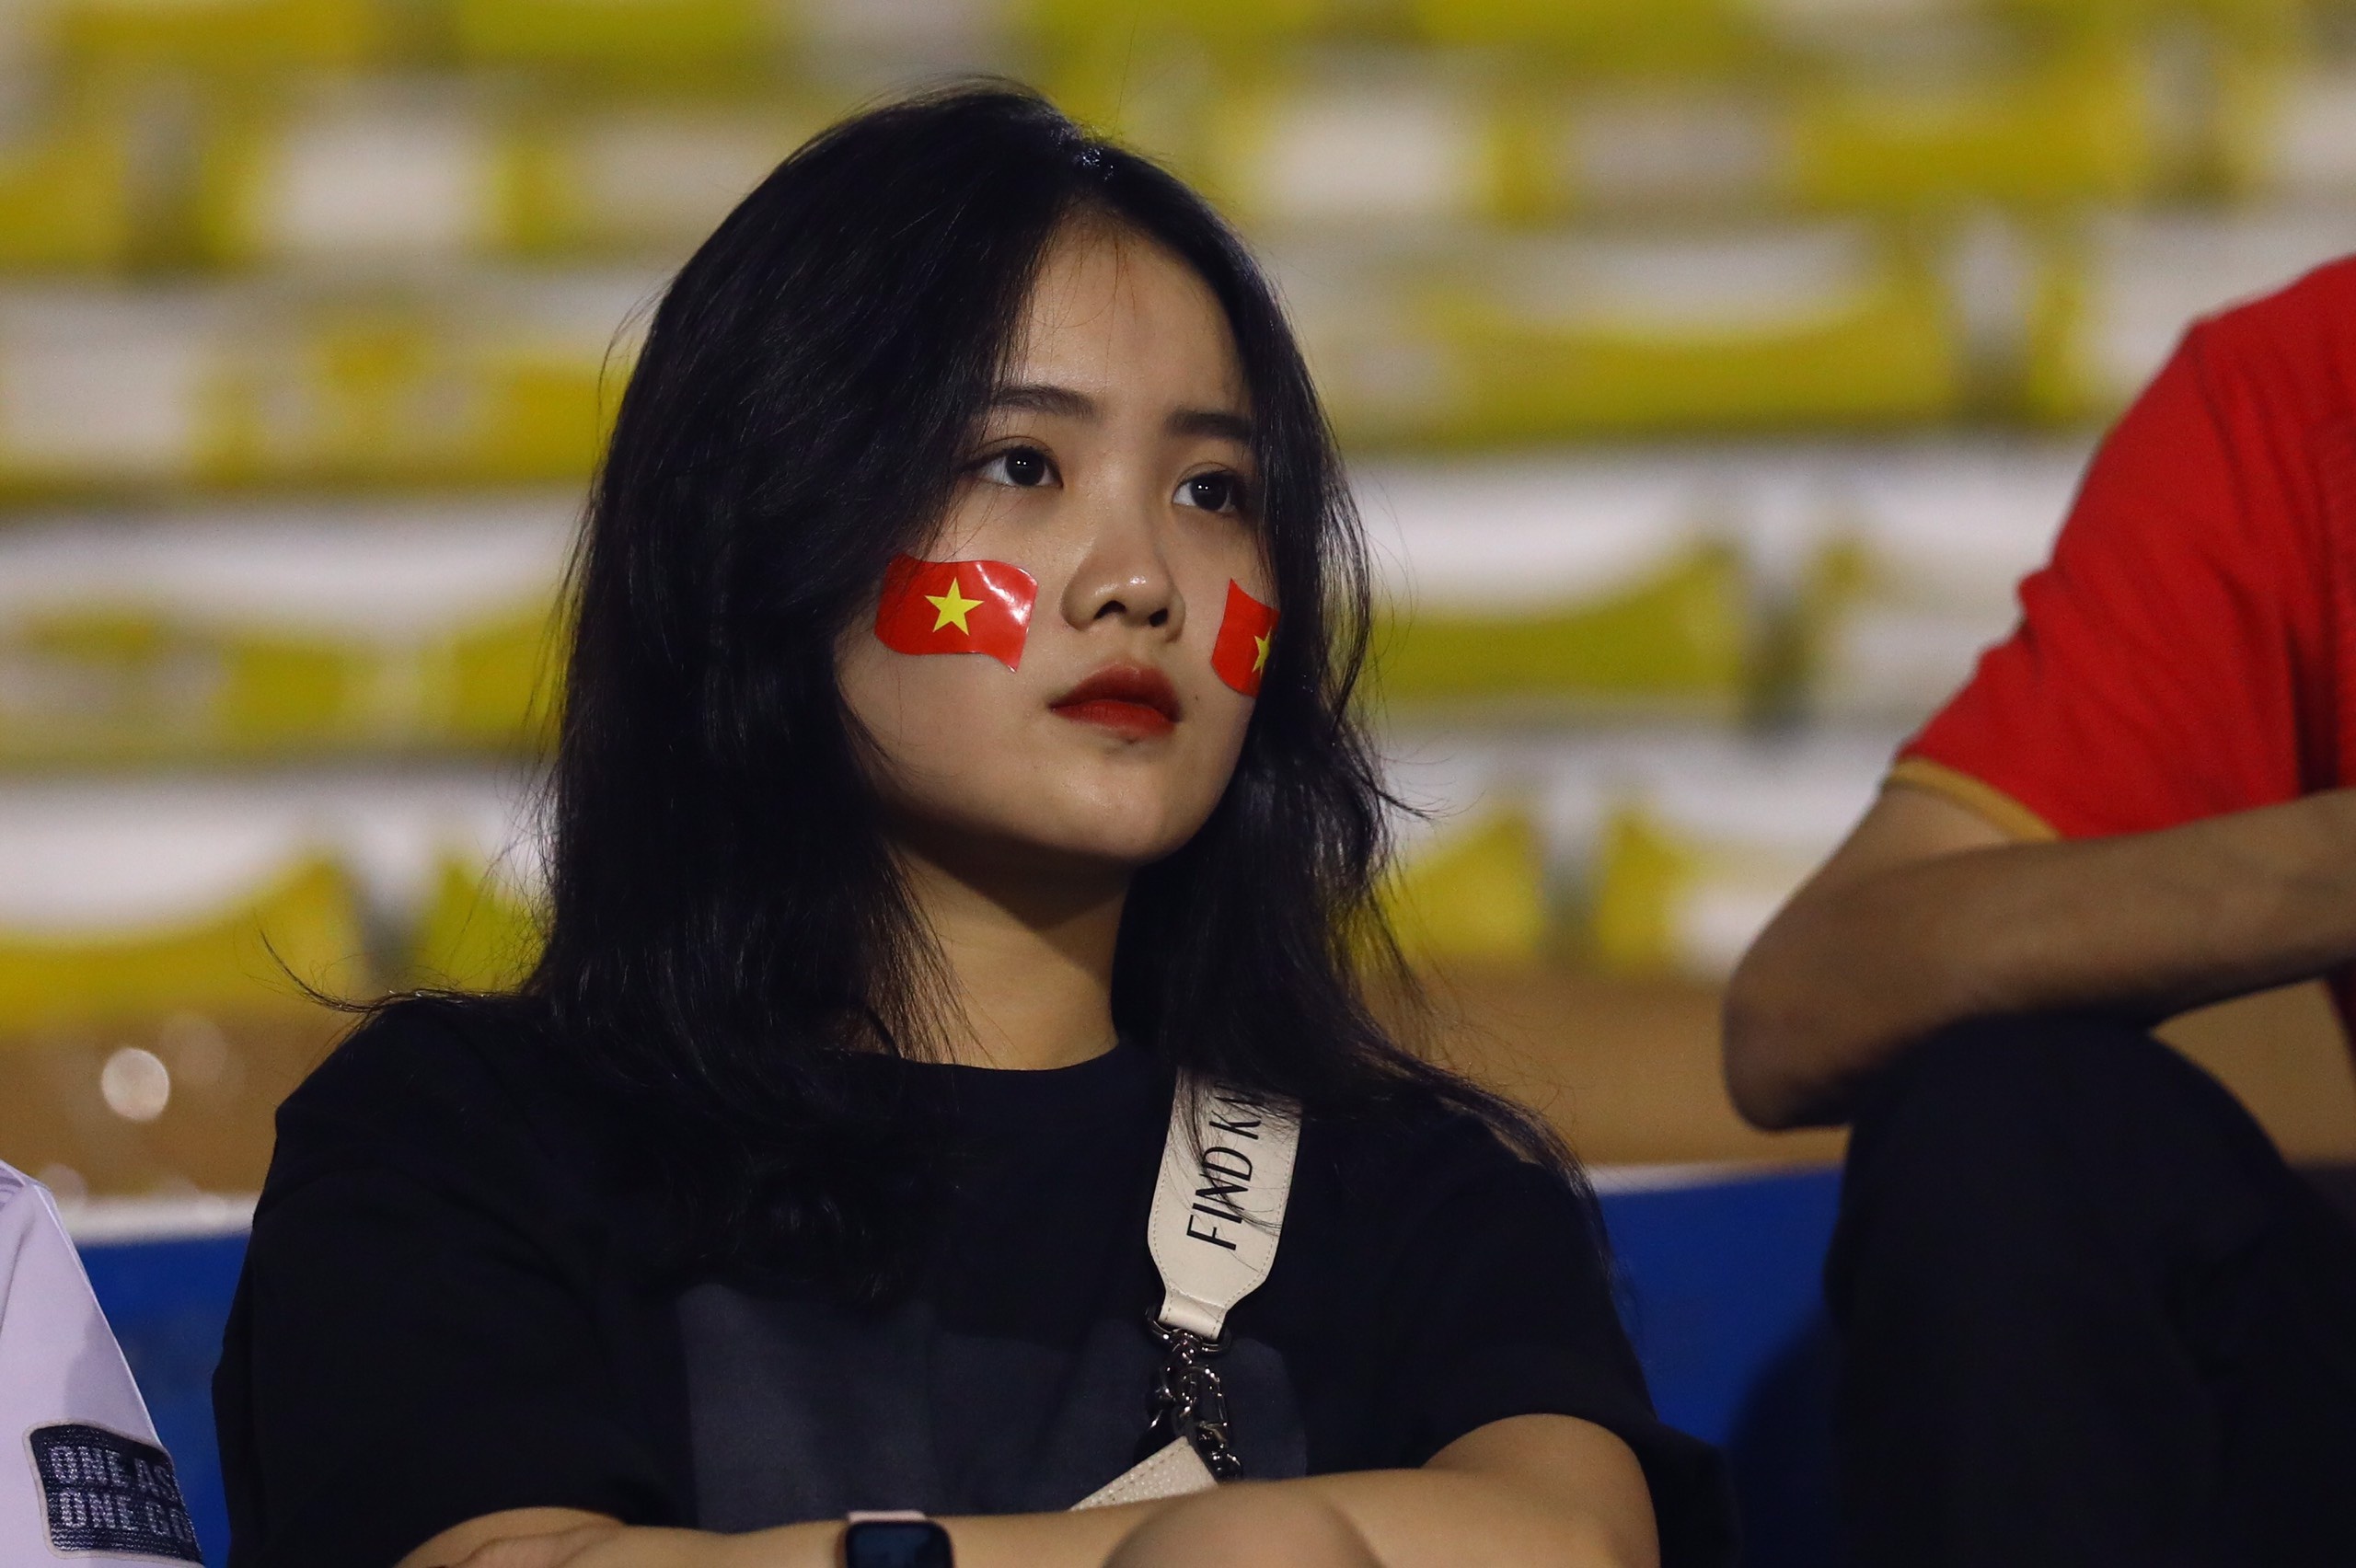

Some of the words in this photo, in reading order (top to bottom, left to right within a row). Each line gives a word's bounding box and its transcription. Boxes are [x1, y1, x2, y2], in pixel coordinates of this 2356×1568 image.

[1186, 1147, 1253, 1251] FIND
[48, 1446, 128, 1488] ONE
[59, 1489, 139, 1531] ONE
